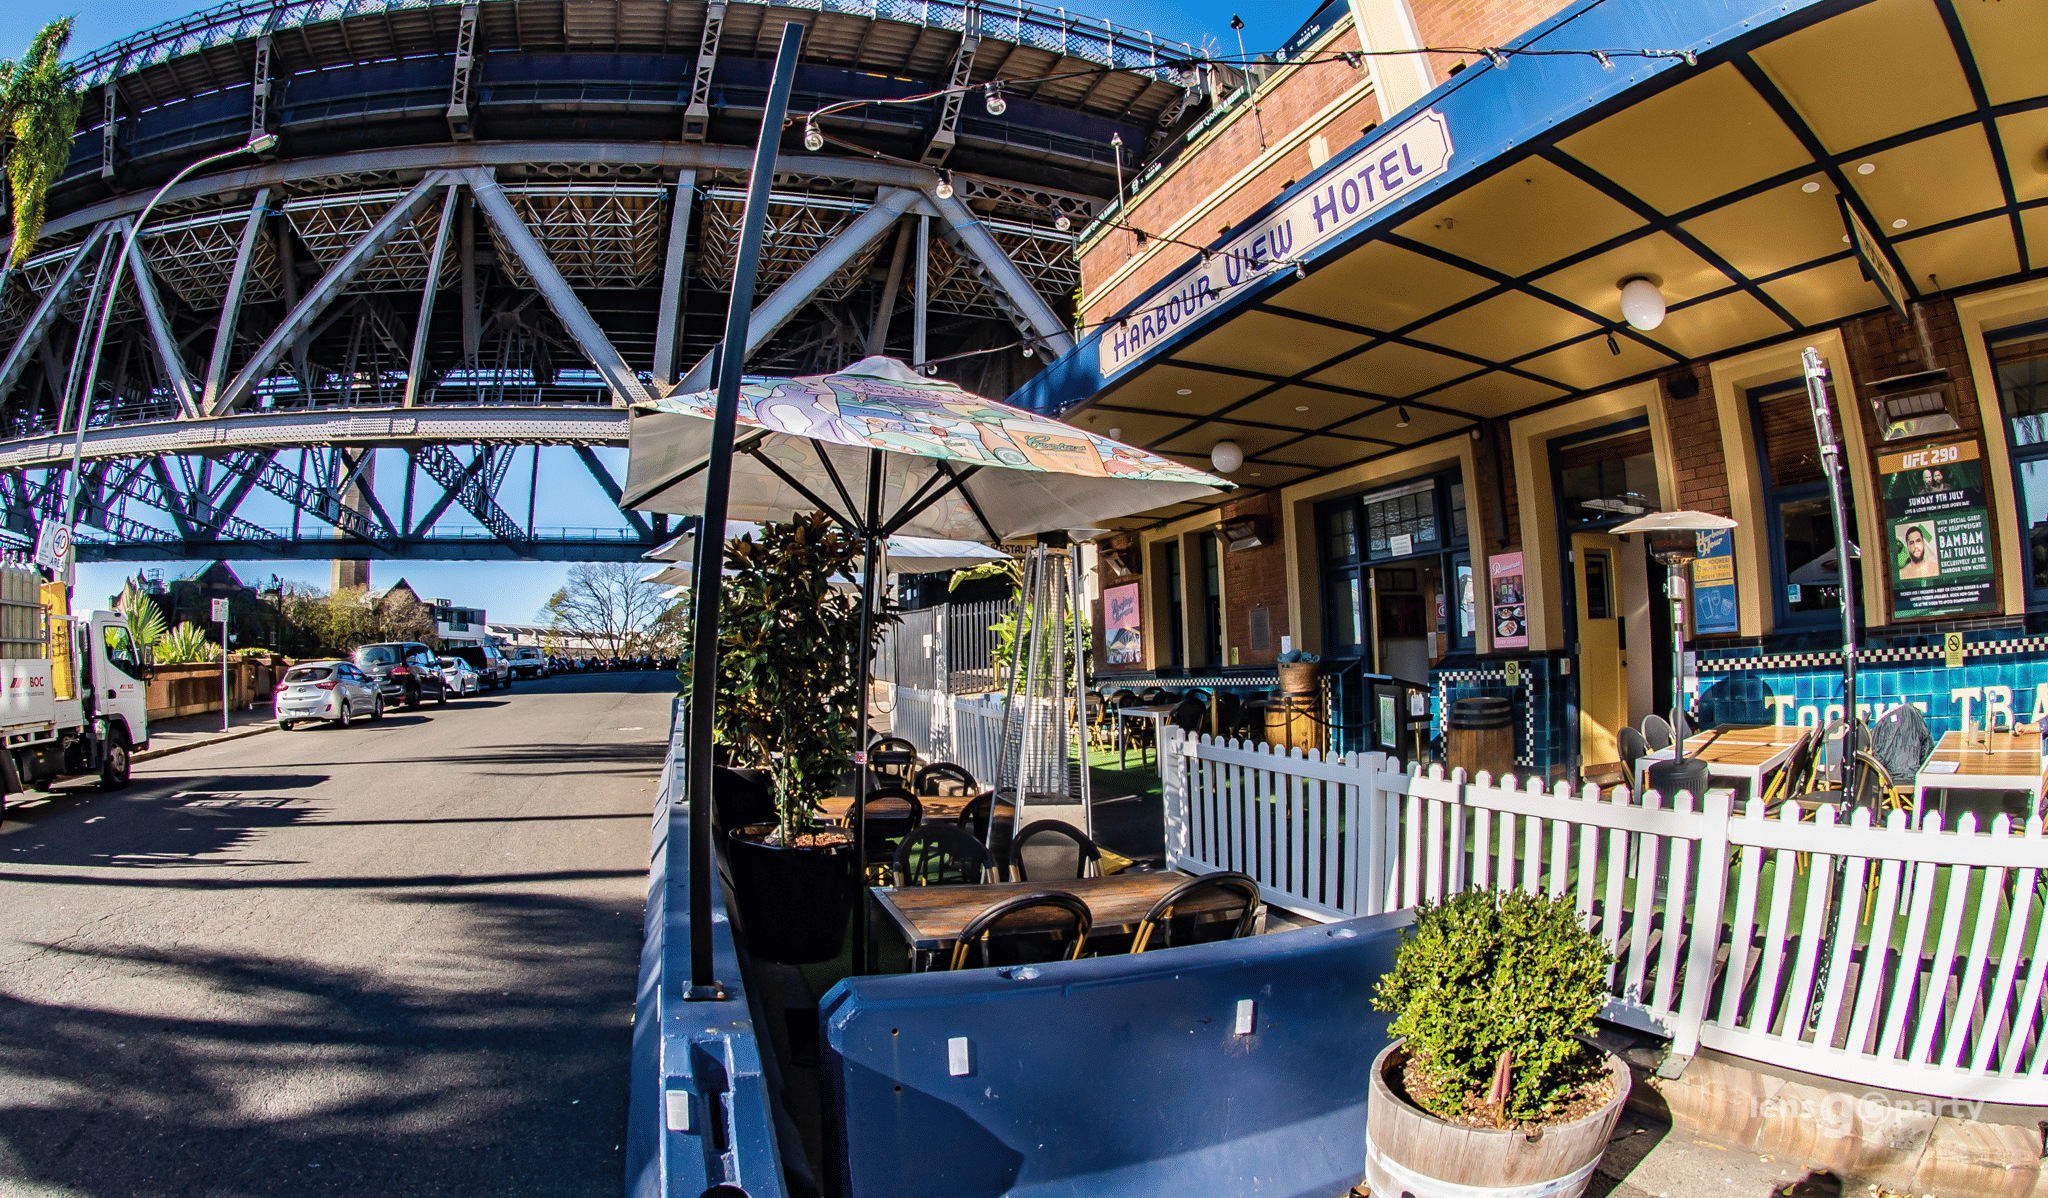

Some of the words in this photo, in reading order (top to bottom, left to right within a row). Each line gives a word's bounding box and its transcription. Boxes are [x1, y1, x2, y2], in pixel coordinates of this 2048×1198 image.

[1113, 274, 1217, 363] HARBOUR
[1223, 218, 1294, 288] VIEW
[1312, 142, 1424, 234] HOTEL
[1902, 451, 1929, 469] UFC
[1931, 446, 1958, 464] 290
[1908, 495, 1934, 507] SUNDAY
[1935, 492, 1948, 503] 9TH
[1949, 490, 1965, 501] JULY
[54, 534, 66, 550] 40
[1939, 530, 1984, 548] BAMBAM
[1940, 549, 1952, 559] TAI
[1954, 546, 1985, 557] TUIVASA
[30, 676, 44, 687] BOC
